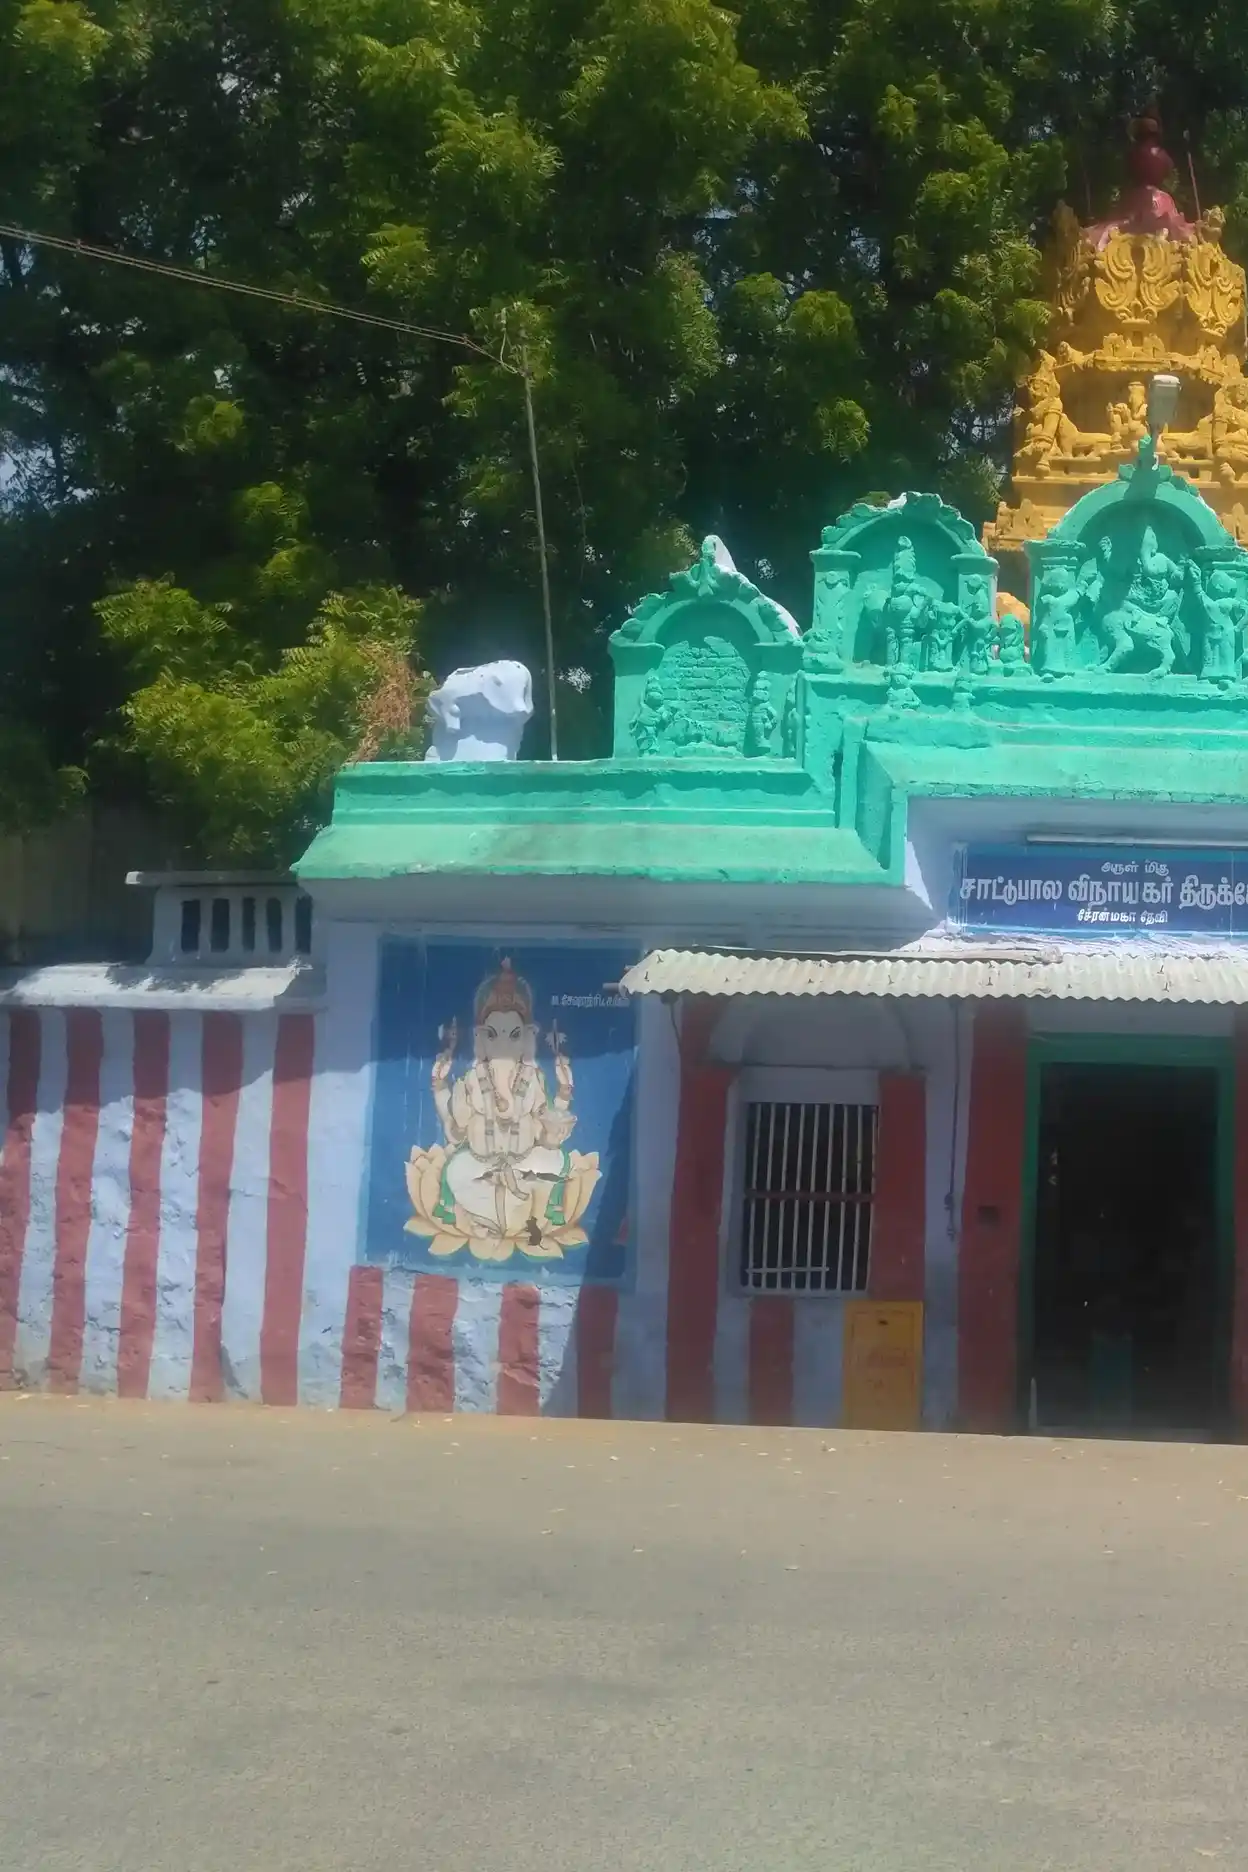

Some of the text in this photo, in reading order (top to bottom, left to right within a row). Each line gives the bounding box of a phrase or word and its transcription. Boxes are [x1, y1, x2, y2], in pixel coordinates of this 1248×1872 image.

[1101, 860, 1170, 877] அருள் மிகு
[960, 876, 1063, 905] சாட்டுபால
[1068, 873, 1174, 908] விநாயகர்
